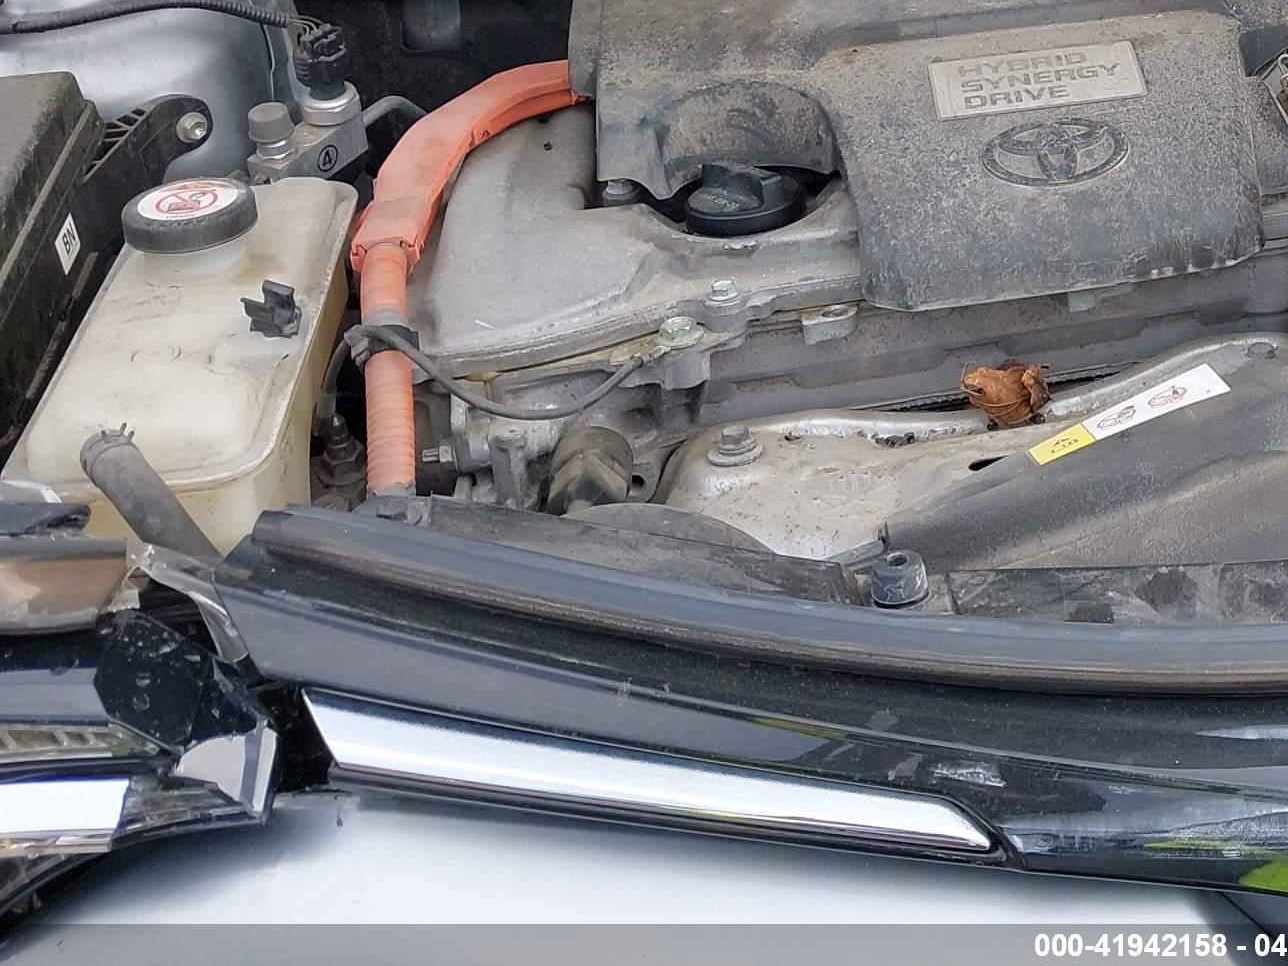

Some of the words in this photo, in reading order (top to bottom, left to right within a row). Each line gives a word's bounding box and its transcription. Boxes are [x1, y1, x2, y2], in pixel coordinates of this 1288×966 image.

[958, 52, 1087, 77] HYBRID
[960, 63, 1120, 94] SYNERGY
[964, 85, 1070, 110] DRIVE
[62, 222, 76, 255] BN
